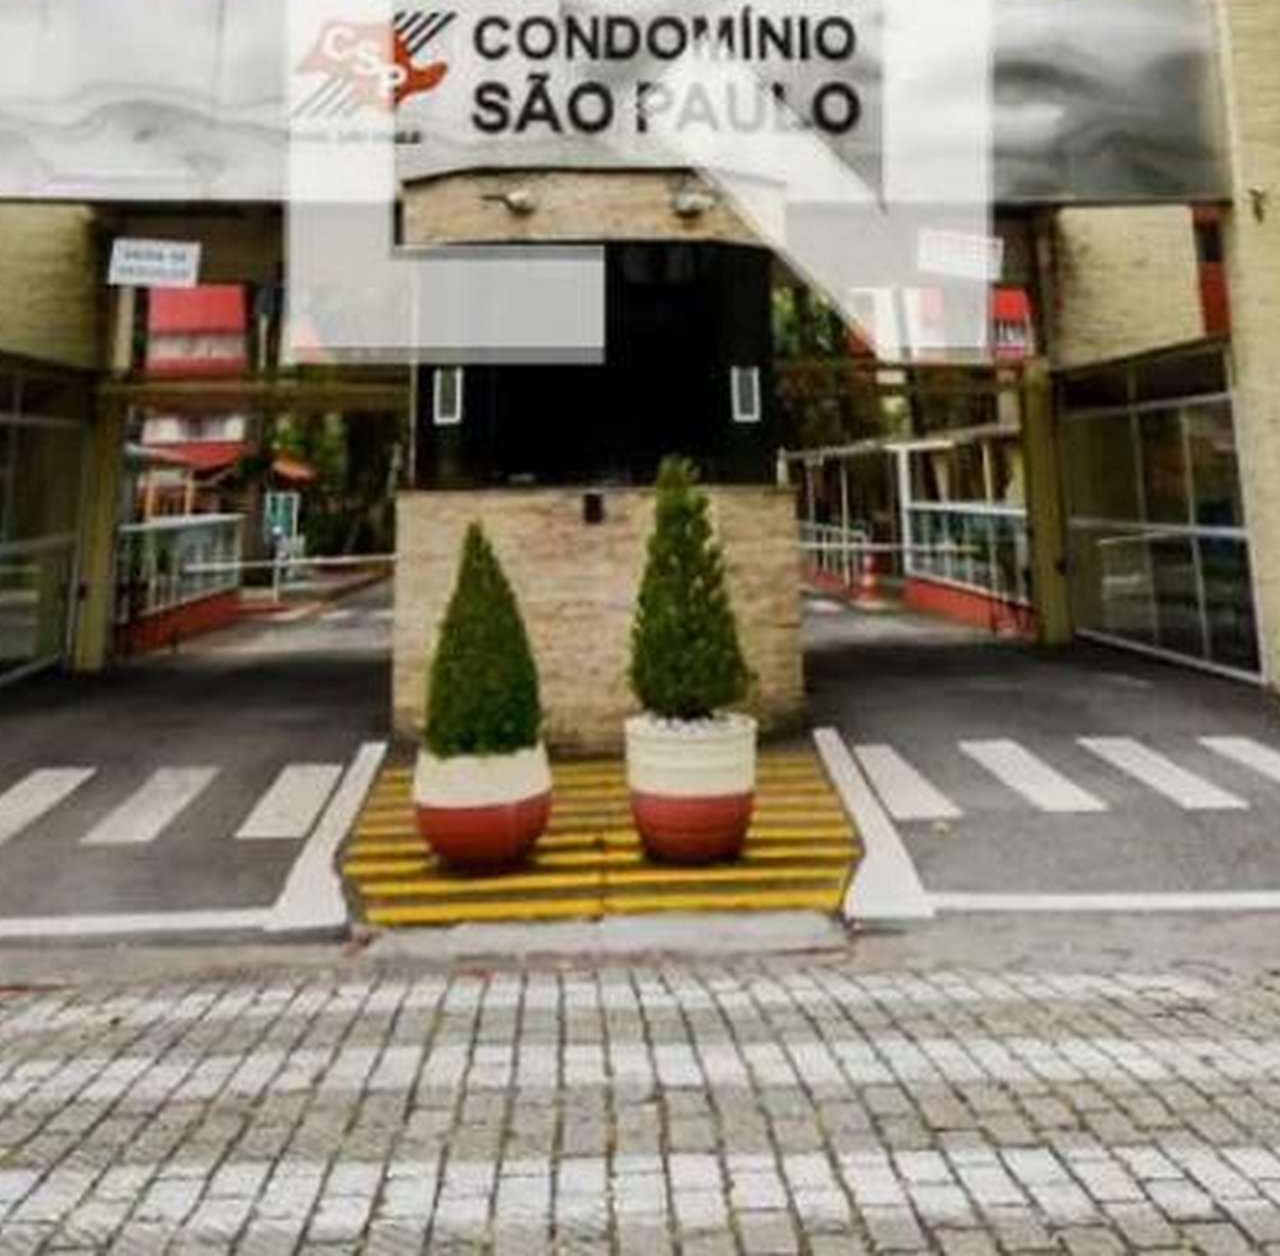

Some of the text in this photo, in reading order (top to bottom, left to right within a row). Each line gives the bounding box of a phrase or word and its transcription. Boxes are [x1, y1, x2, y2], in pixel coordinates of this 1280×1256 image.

[472, 5, 856, 61] CONDOMÍNIO
[322, 25, 409, 106] CSP
[471, 73, 862, 135] SÃO PAULO
